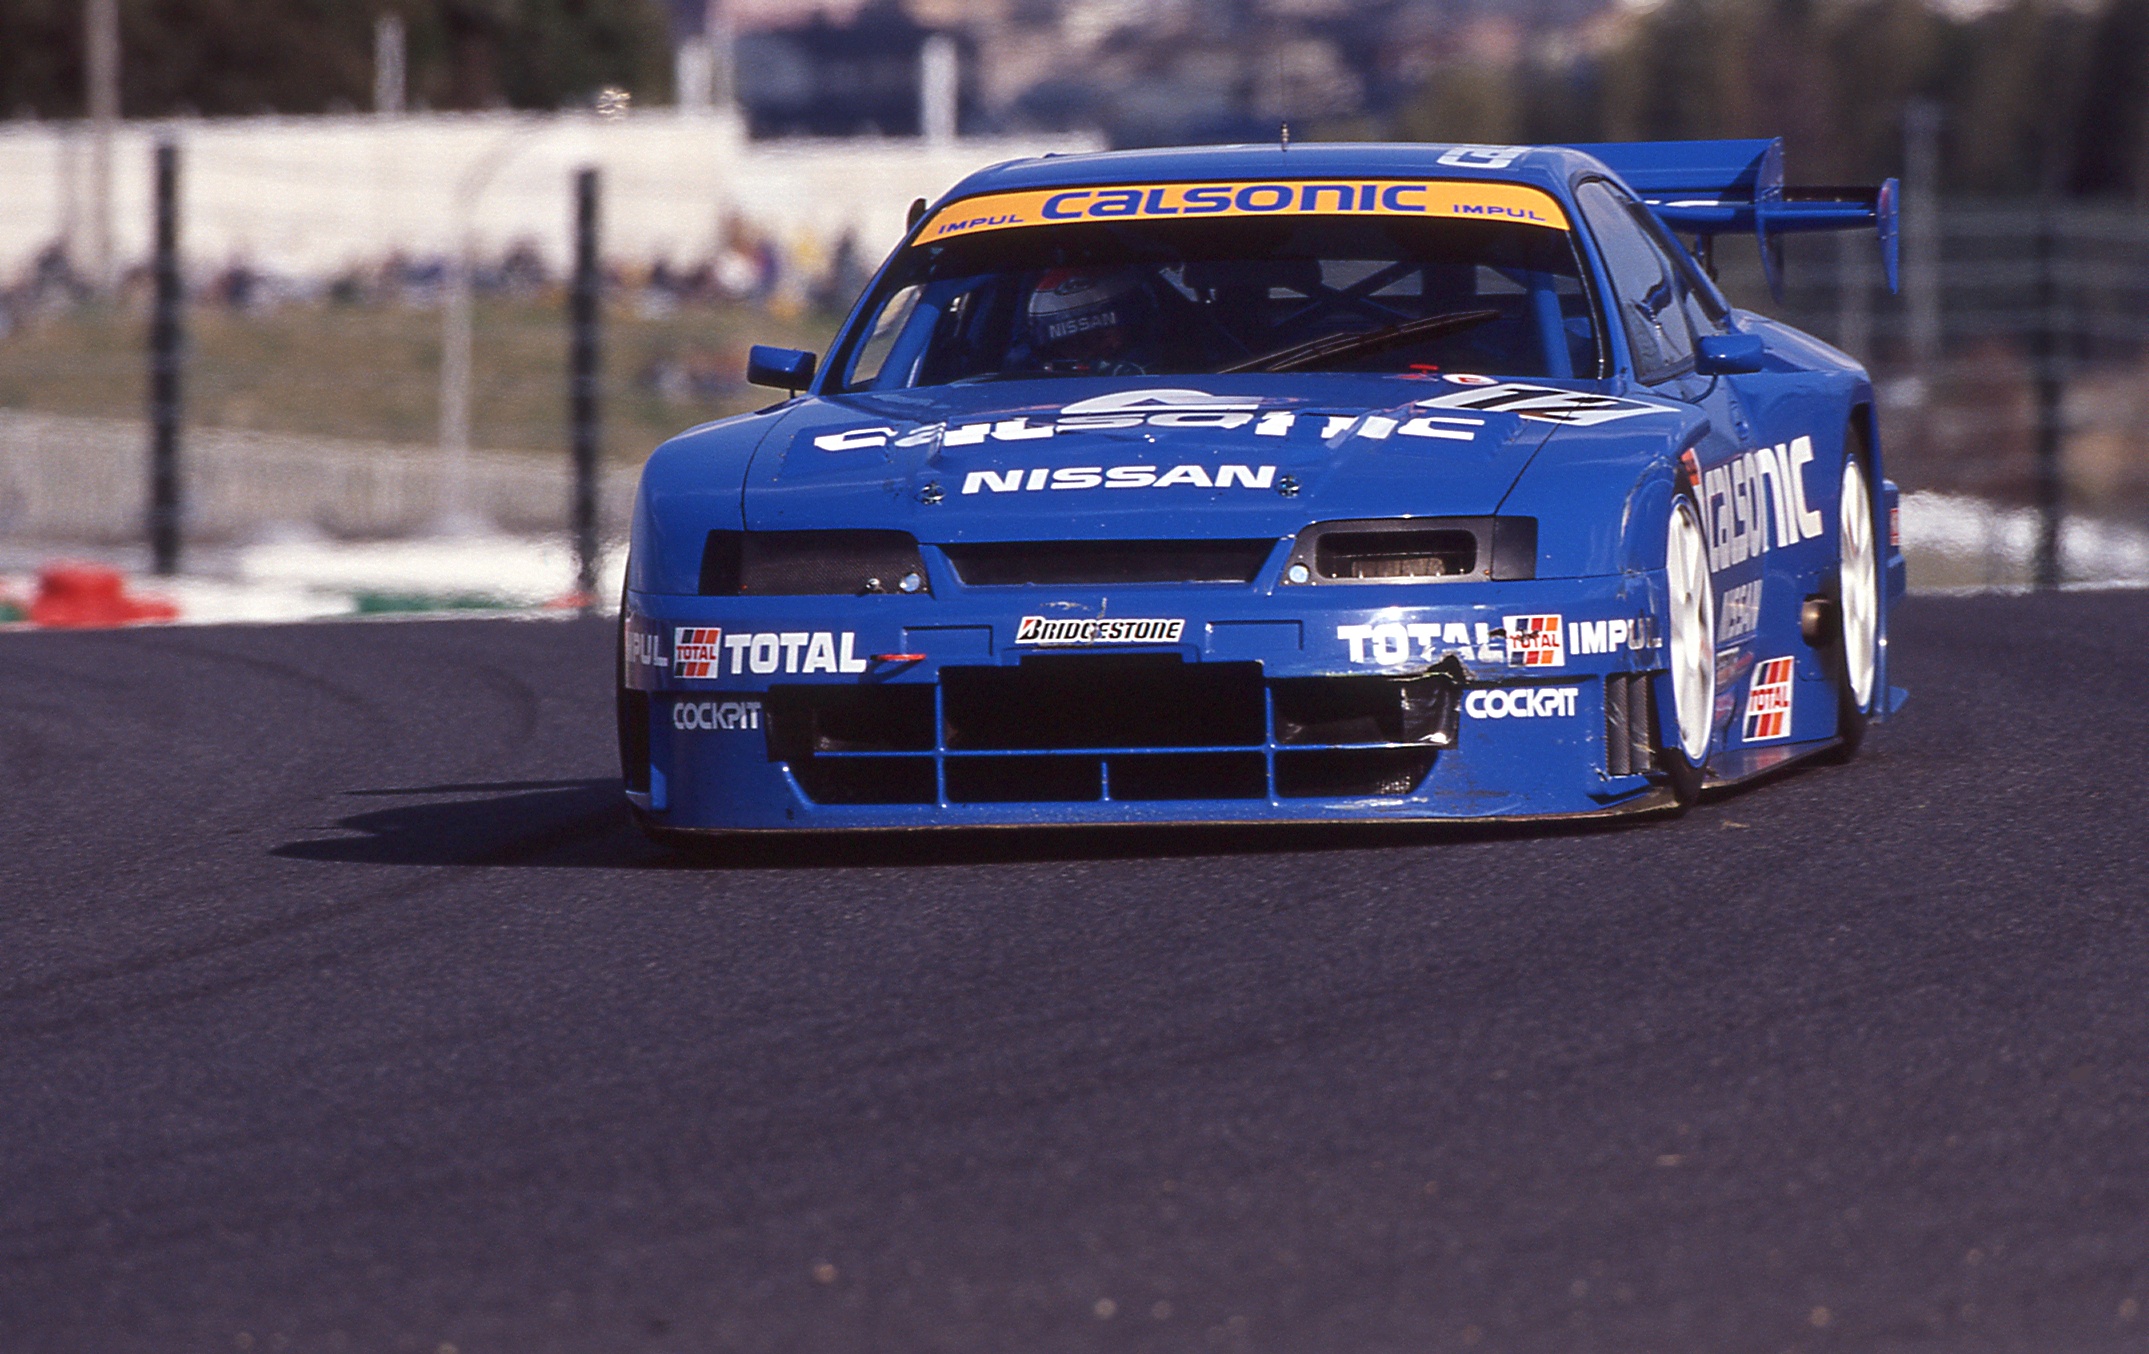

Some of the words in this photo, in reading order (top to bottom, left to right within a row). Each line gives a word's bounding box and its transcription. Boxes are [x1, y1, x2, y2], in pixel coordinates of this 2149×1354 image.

[938, 214, 1024, 235] IMPUL
[1453, 204, 1546, 221] IMPUL
[1049, 312, 1116, 339] NISSAN
[961, 465, 1276, 494] NISSAN
[1016, 618, 1184, 641] BRIDGESTONE
[1337, 622, 1508, 665] TOTAL
[1510, 634, 1560, 649] TOTAL
[1569, 618, 1663, 655] IMPUL
[677, 646, 717, 660] TOTAL
[725, 632, 867, 674] TOTAL
[1465, 687, 1579, 719] COCKPIT
[1750, 685, 1789, 712] TOTAL
[673, 702, 762, 730] COCKPIT
